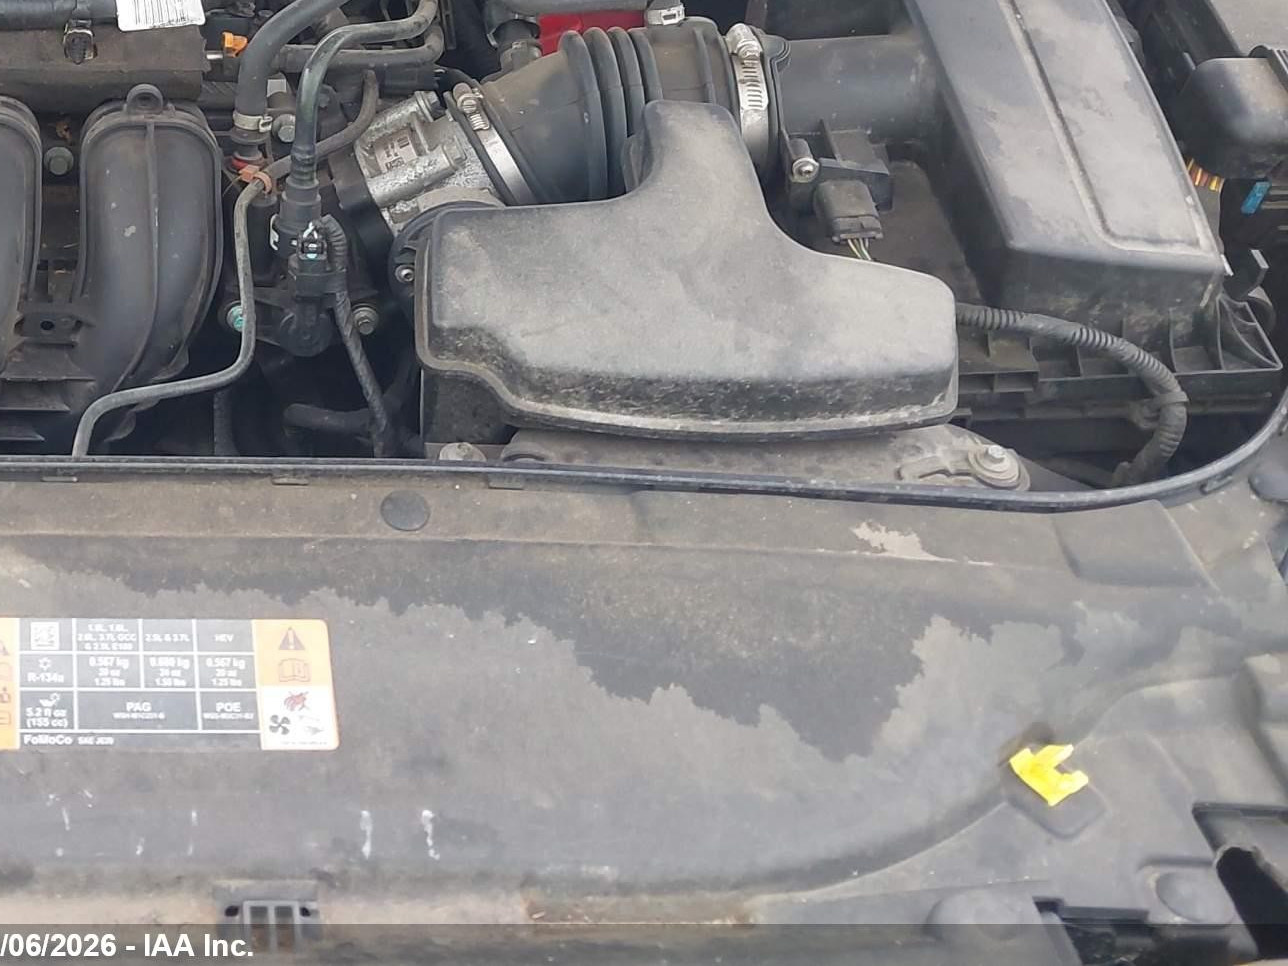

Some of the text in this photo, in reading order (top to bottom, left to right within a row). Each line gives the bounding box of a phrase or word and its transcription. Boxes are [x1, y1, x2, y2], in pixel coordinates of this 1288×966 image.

[116, 656, 130, 670] kg
[177, 657, 190, 670] kg
[233, 657, 246, 670] kg
[27, 672, 65, 683] R-134a
[26, 707, 42, 717] 5.2
[53, 709, 67, 717] oz
[126, 701, 152, 712] PAG
[216, 702, 241, 712] POE
[26, 718, 68, 728] (155 cc)
[23, 734, 73, 745] FoMoCo
